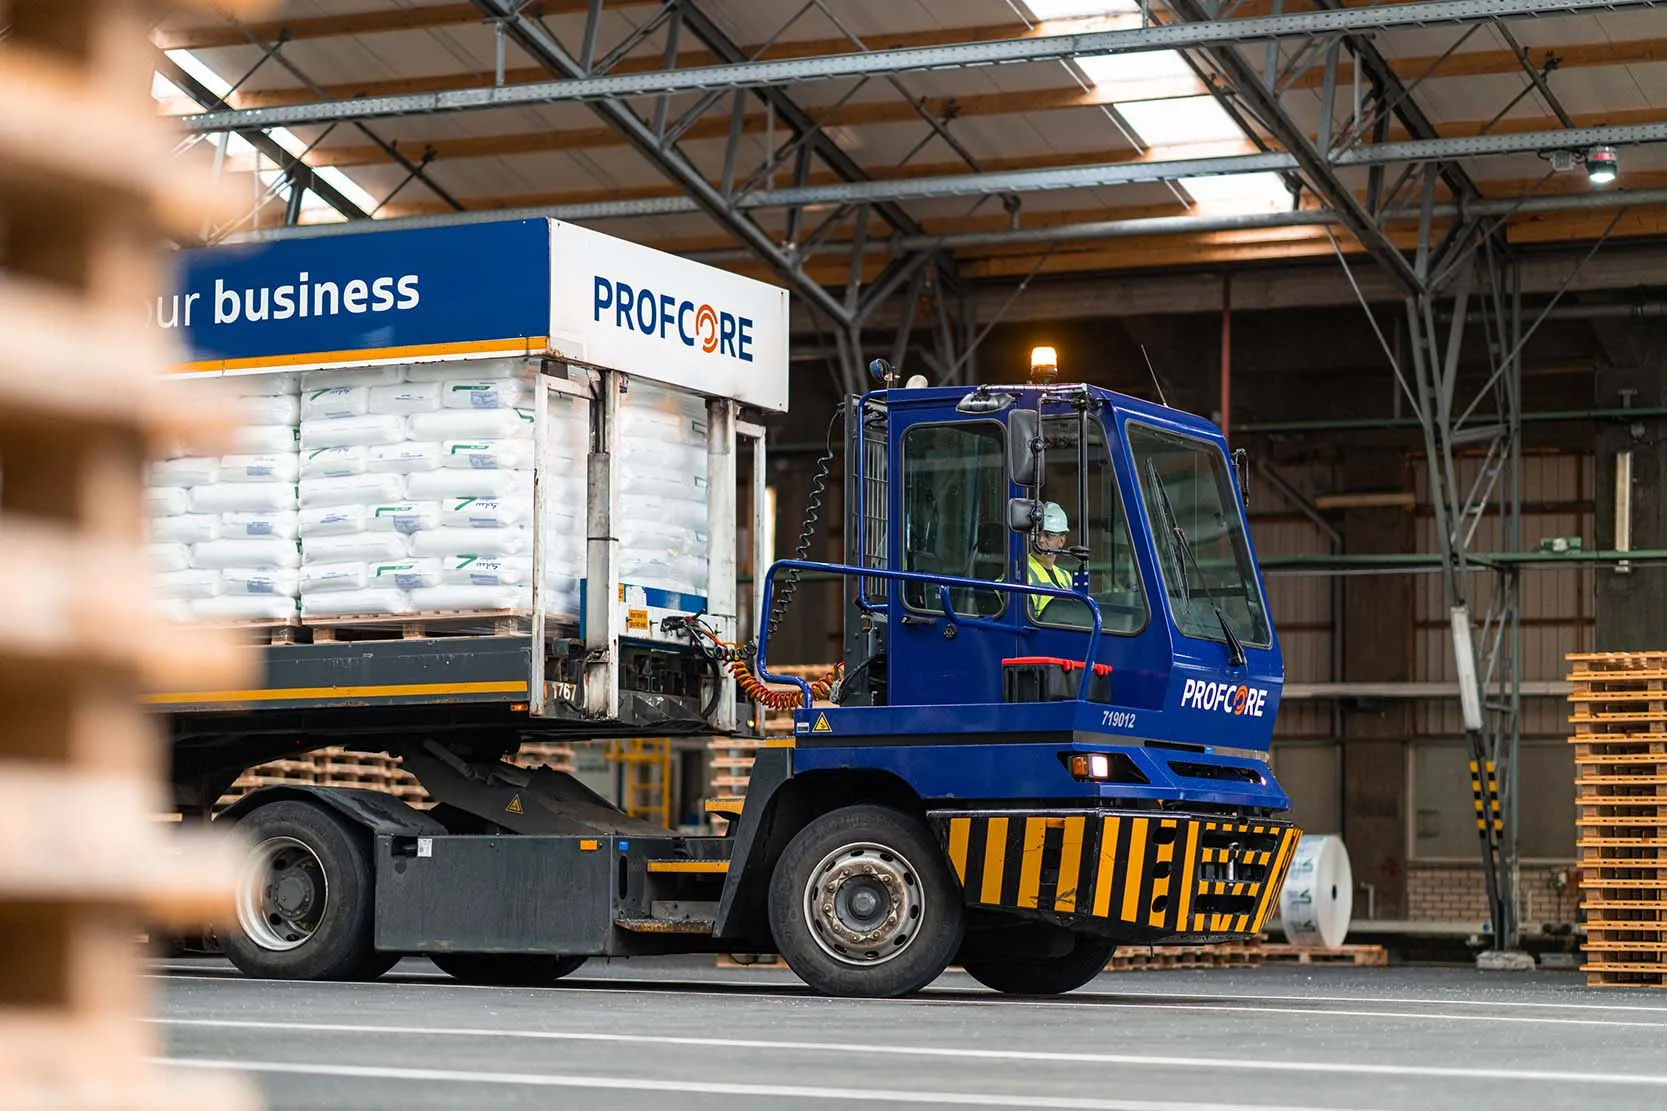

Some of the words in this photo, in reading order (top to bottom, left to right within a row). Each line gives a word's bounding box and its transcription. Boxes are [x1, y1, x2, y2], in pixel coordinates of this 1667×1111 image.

[150, 293, 200, 328] ur
[213, 271, 420, 324] business
[593, 275, 753, 362] PROFCORE
[552, 682, 577, 701] 1767
[1180, 678, 1268, 718] PROFCORE
[1101, 710, 1136, 729] 719012
